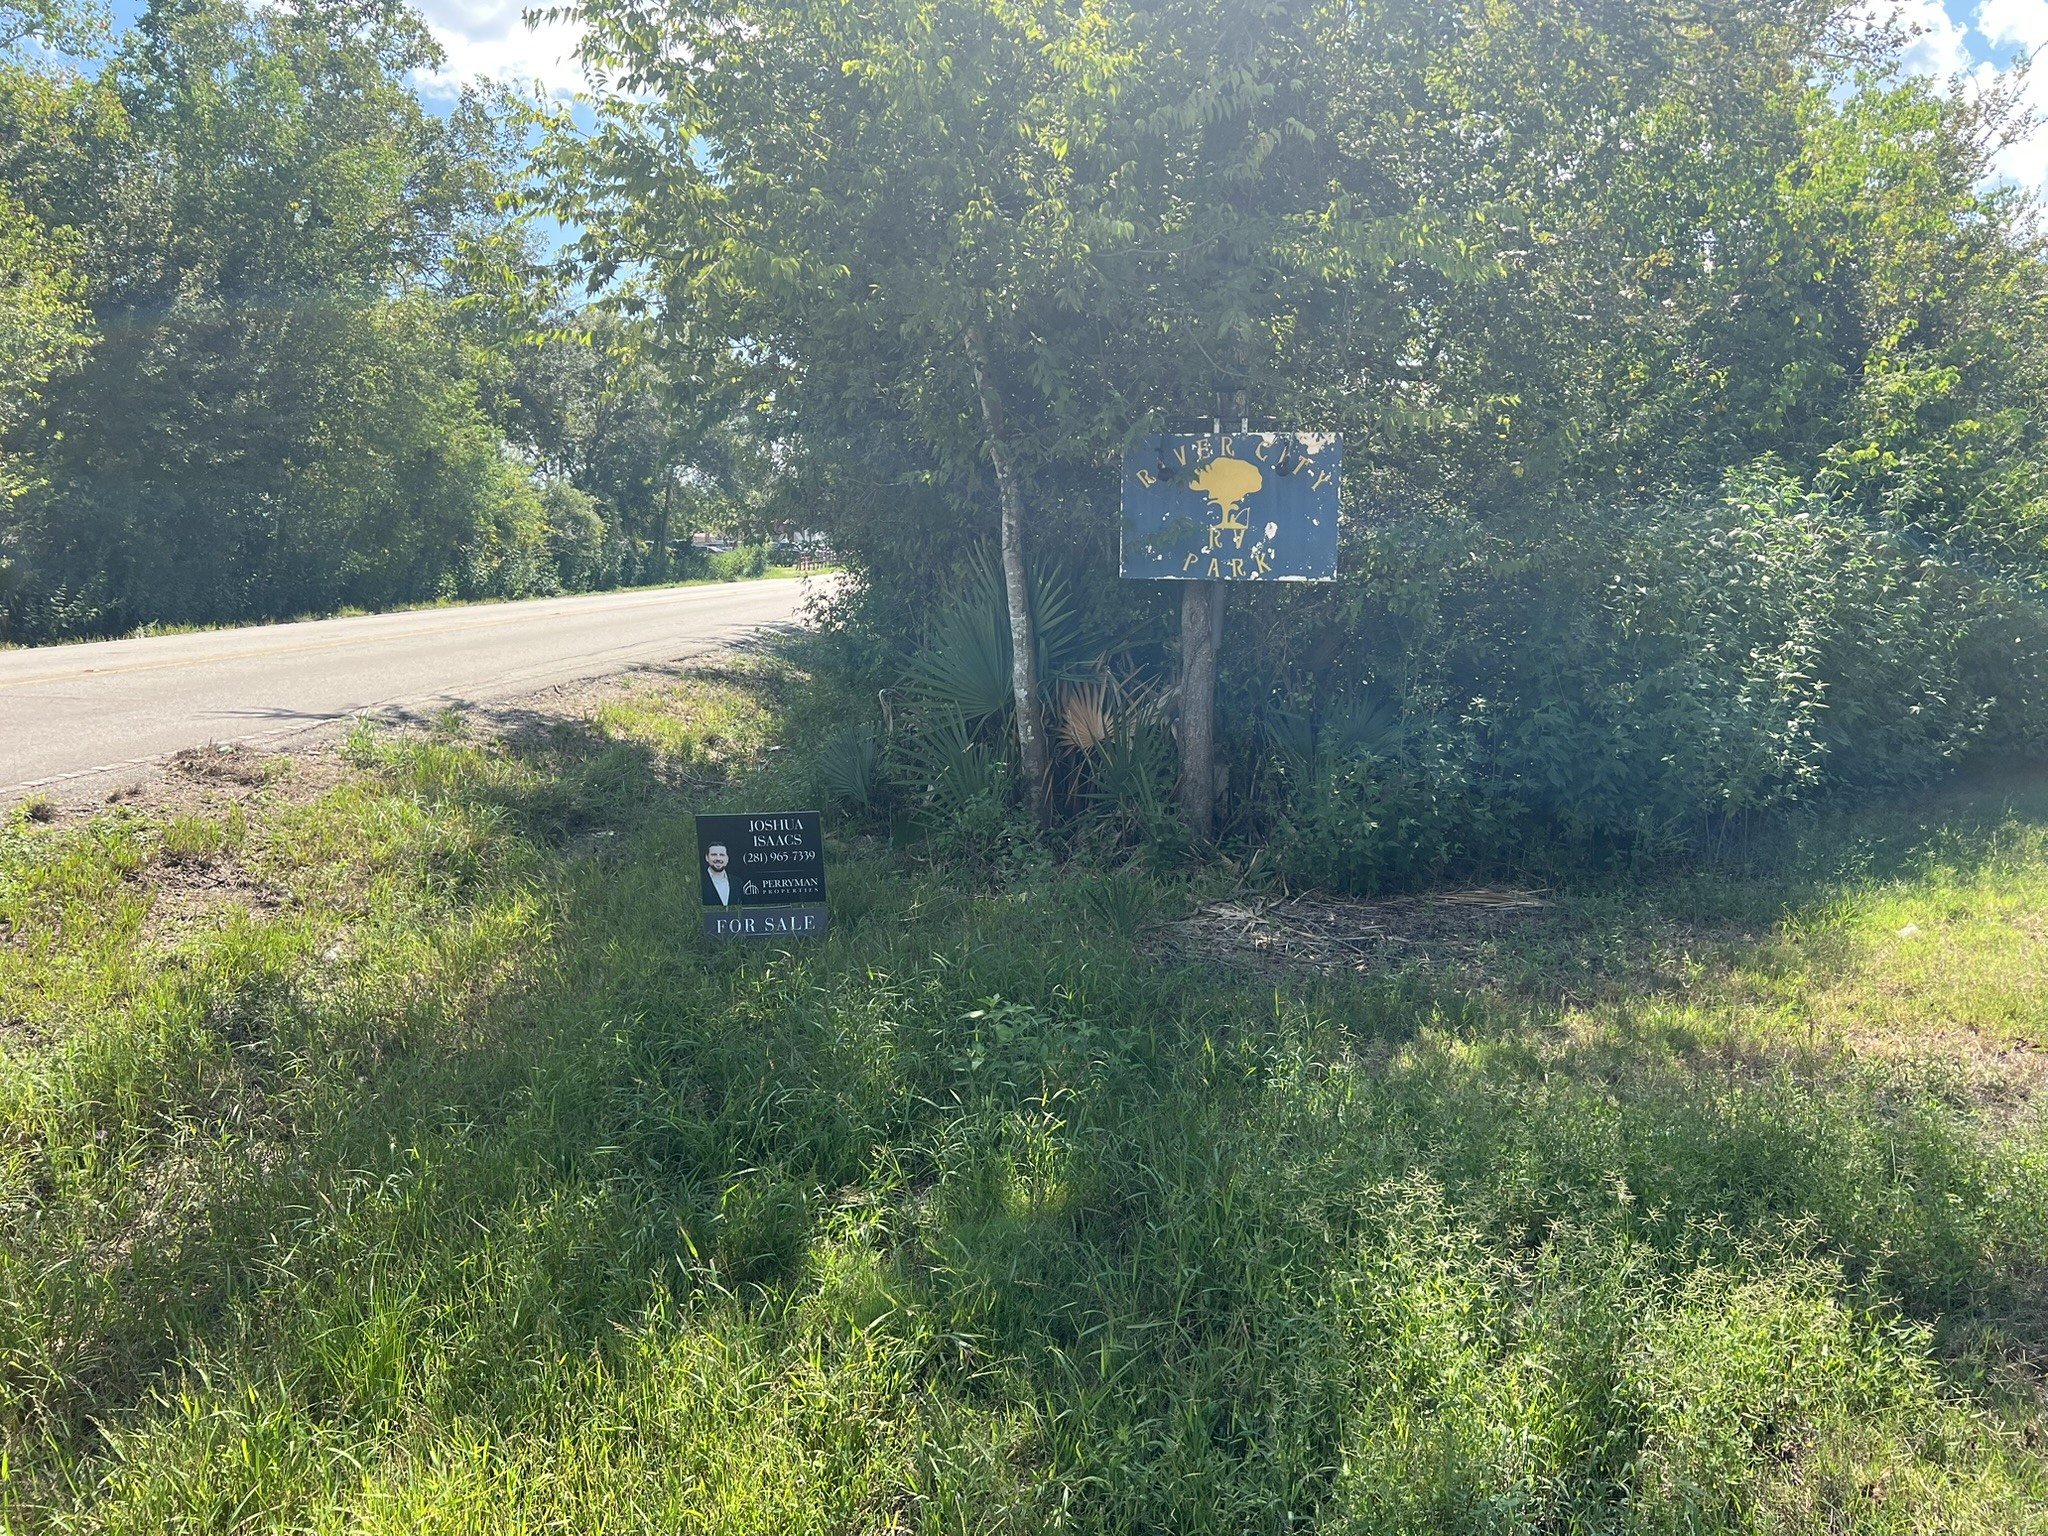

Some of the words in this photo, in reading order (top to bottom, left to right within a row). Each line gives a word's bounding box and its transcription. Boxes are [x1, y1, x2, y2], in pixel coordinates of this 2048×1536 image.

[1136, 436, 1235, 489] RVER
[1209, 527, 1245, 549] RV
[1183, 552, 1272, 577] PARK
[748, 818, 804, 832] JOSHUA
[753, 833, 803, 847] ISAACS
[743, 852, 768, 864] (281)
[770, 851, 789, 862] 965
[792, 850, 816, 861] 7339
[762, 878, 819, 888] PERRYMAN
[762, 887, 819, 895] PROPERTIES
[717, 918, 756, 934] FOR
[764, 915, 816, 932] SALE
